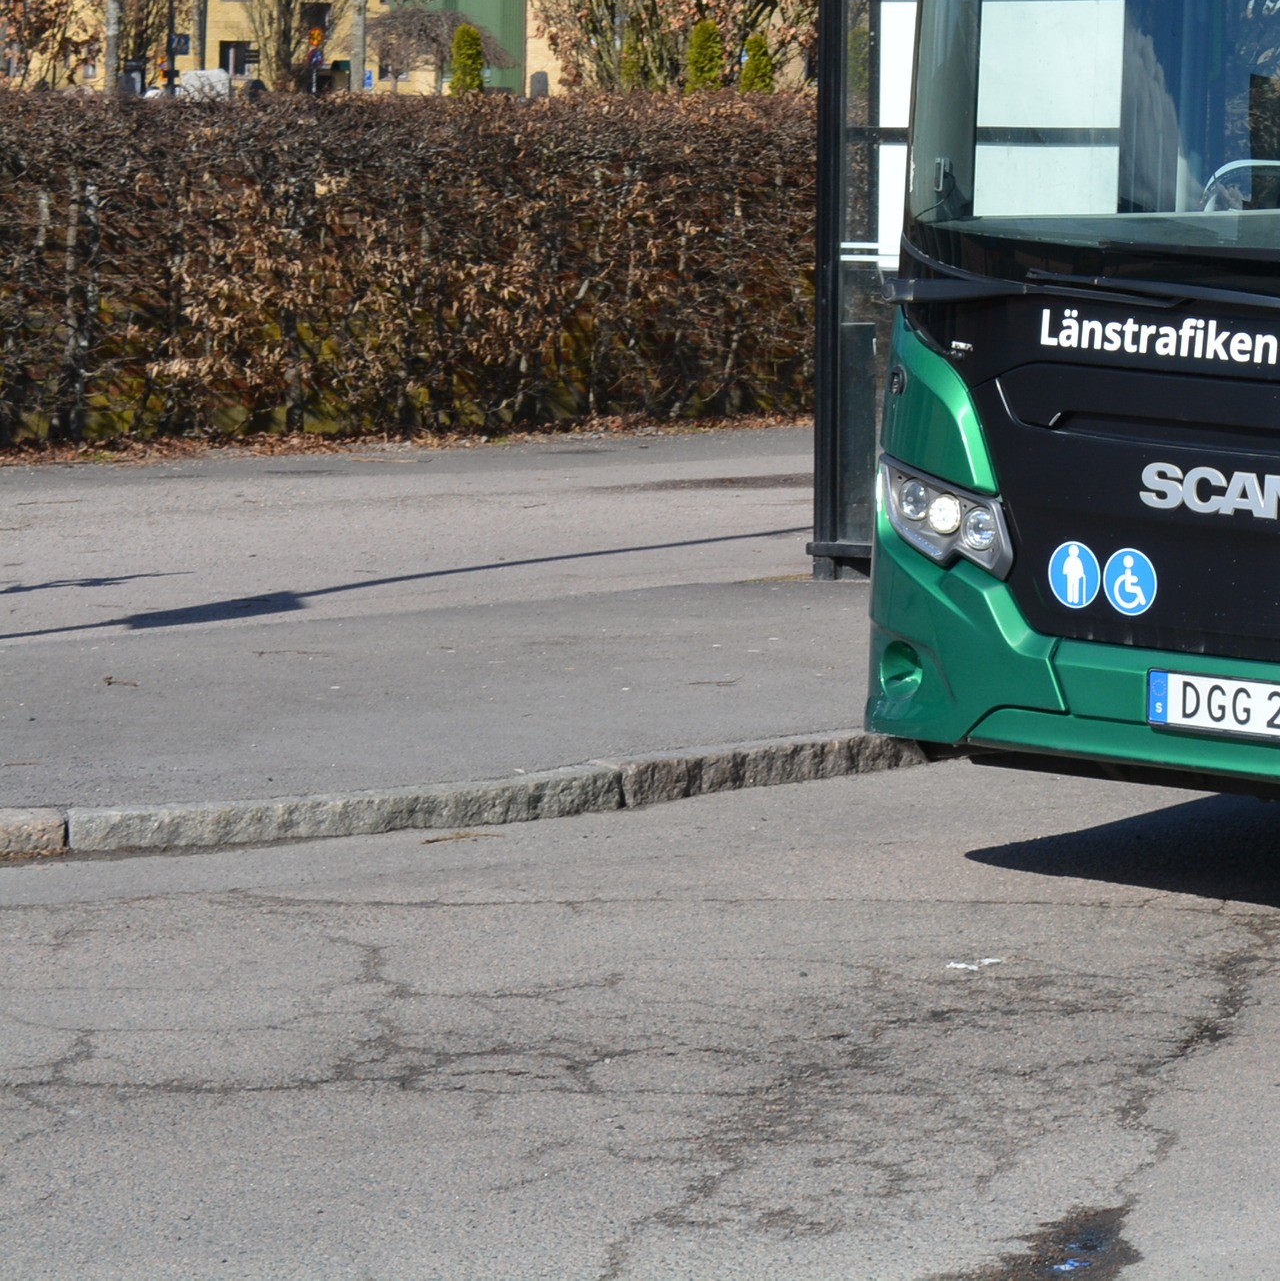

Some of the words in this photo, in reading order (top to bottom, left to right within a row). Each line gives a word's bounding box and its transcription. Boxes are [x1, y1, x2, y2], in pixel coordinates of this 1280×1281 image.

[1040, 309, 1278, 365] Länstrafiken
[1155, 702, 1163, 714] S
[1182, 680, 1252, 726] DGG
